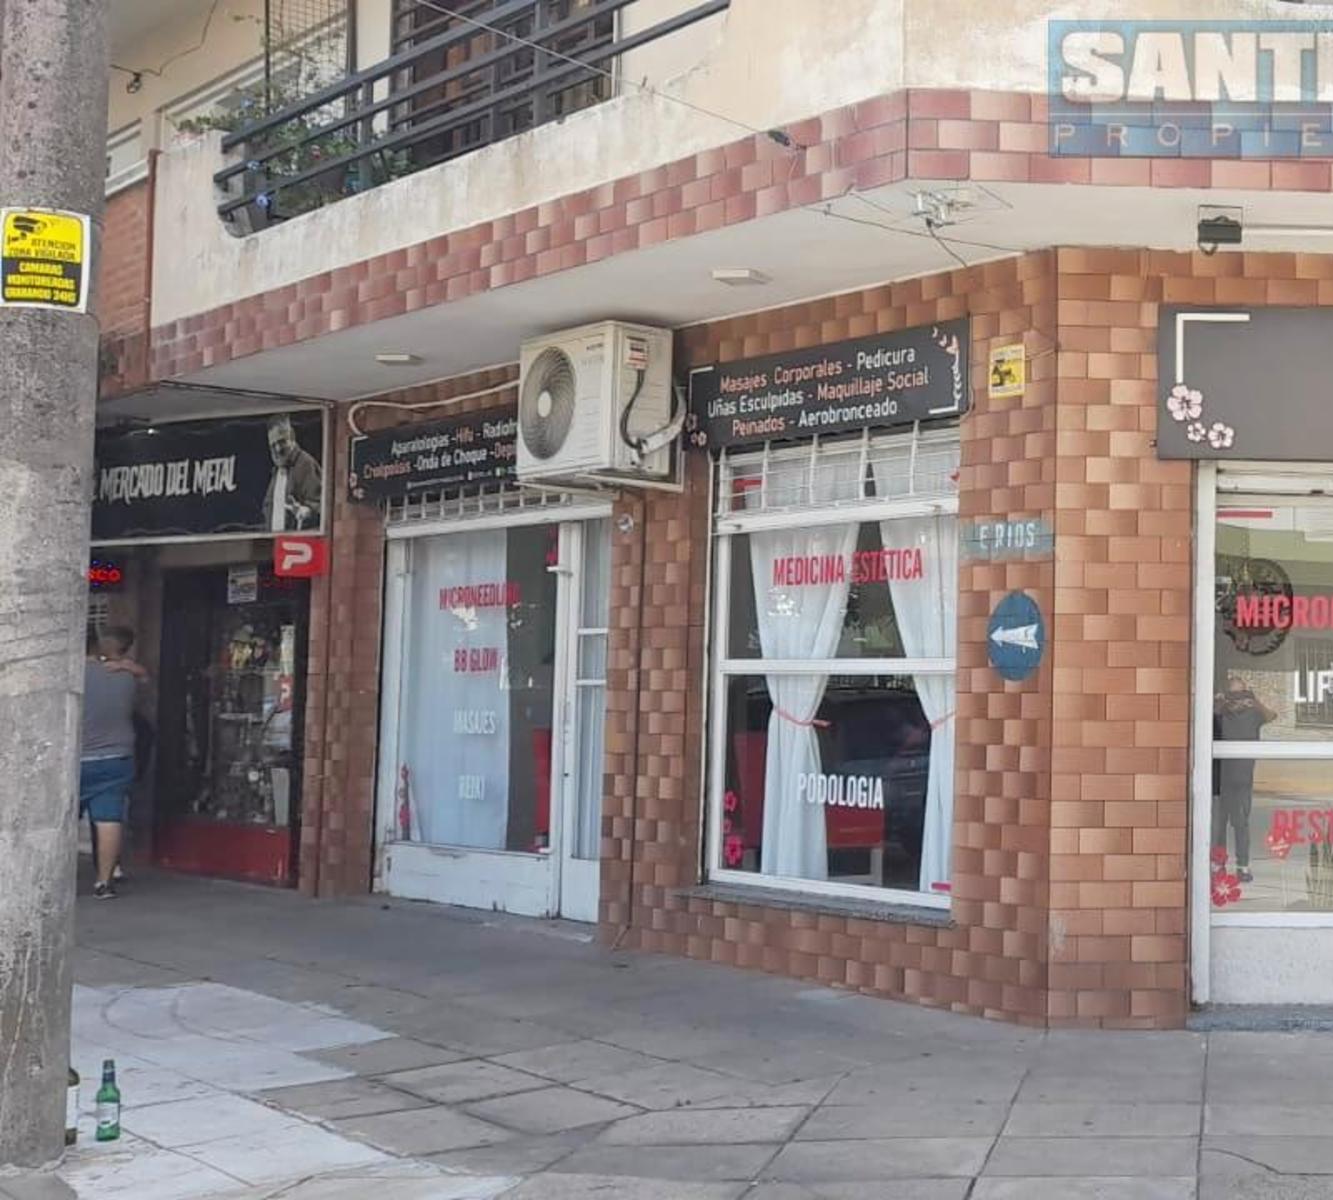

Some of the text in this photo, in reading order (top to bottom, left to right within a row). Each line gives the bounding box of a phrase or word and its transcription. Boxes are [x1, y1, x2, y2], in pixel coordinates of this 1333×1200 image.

[719, 373, 767, 394] Masajes
[774, 360, 843, 385] Corporales
[857, 348, 916, 370] Pedicura
[708, 401, 736, 418] Uñas
[739, 388, 804, 414] Esculpidas
[817, 377, 883, 401] Maquillaje
[887, 366, 929, 390] Social
[732, 416, 785, 437] Peinados
[797, 398, 898, 428] Aerobronceado
[441, 449, 452, 467] de
[453, 446, 487, 467] Choque
[100, 454, 237, 505] MERCADO DEL METAL
[773, 555, 845, 586] MEDICINA
[454, 647, 498, 673] BB GLOW
[453, 709, 497, 735] MASAJES
[798, 773, 884, 809] PODOLOGIA
